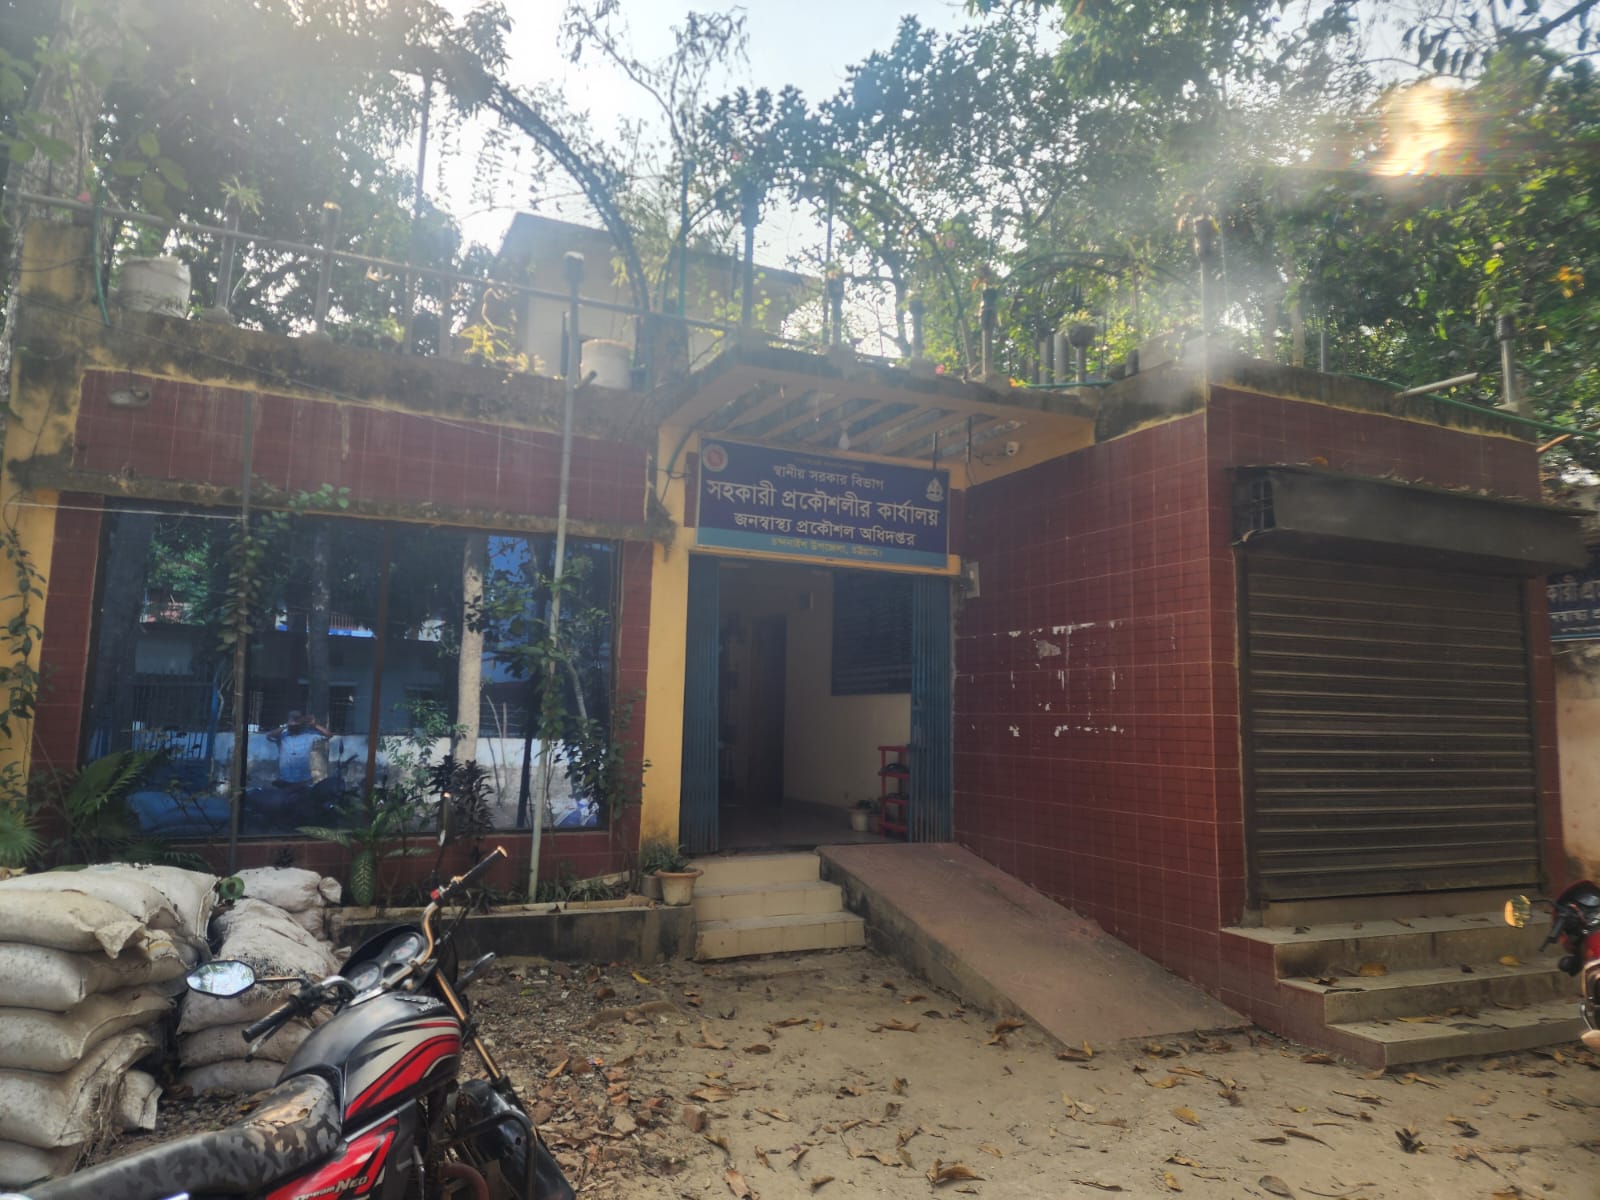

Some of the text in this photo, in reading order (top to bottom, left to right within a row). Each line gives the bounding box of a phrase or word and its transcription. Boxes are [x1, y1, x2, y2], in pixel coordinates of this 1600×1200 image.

[808, 470, 849, 486] সরকার
[851, 473, 884, 491] বিভাগ
[706, 479, 940, 527] সহকারী প্রকৌশলীর কার্যালয়
[733, 513, 917, 546] জনস্বাস্থ্য প্রকৌশল অধিদপ্তর
